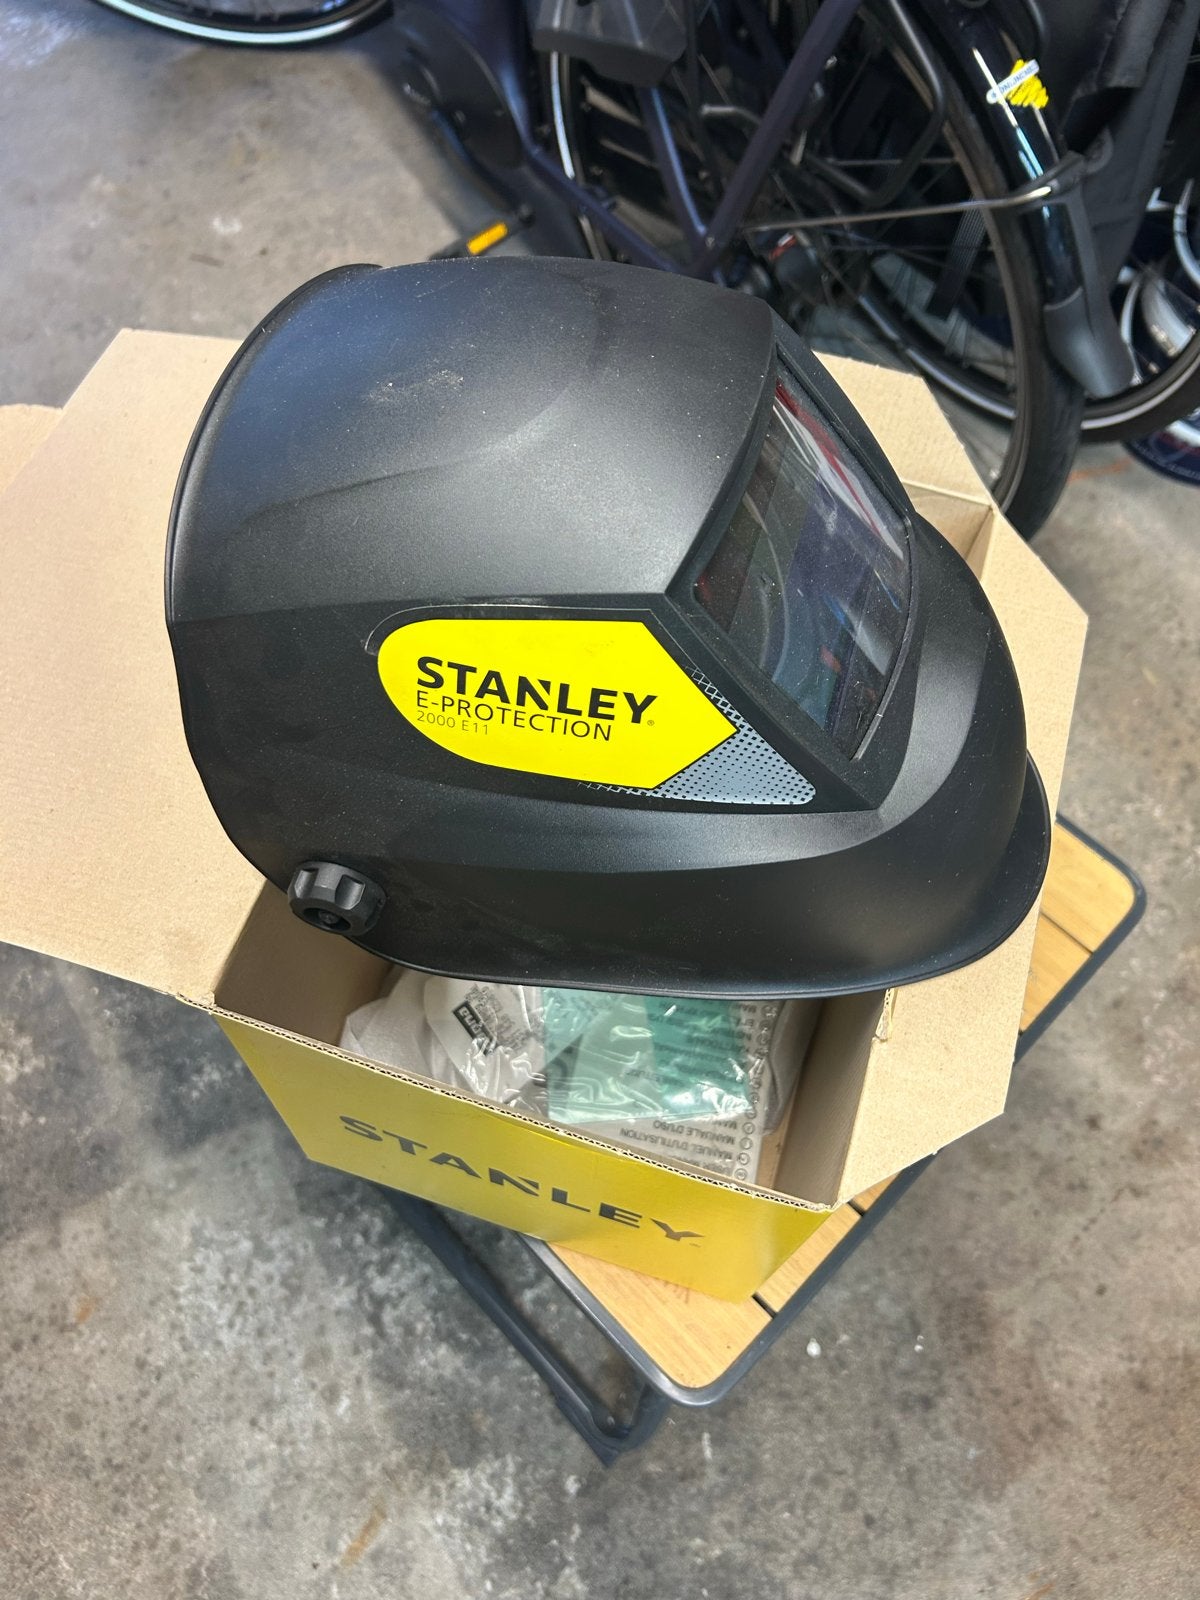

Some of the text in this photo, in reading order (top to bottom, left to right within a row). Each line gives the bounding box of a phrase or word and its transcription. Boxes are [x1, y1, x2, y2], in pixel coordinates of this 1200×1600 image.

[417, 656, 658, 724] STANLEY
[417, 690, 611, 741] E-PROTECTION
[417, 710, 488, 735] 2000 E11
[340, 1115, 705, 1241] STANLEY
